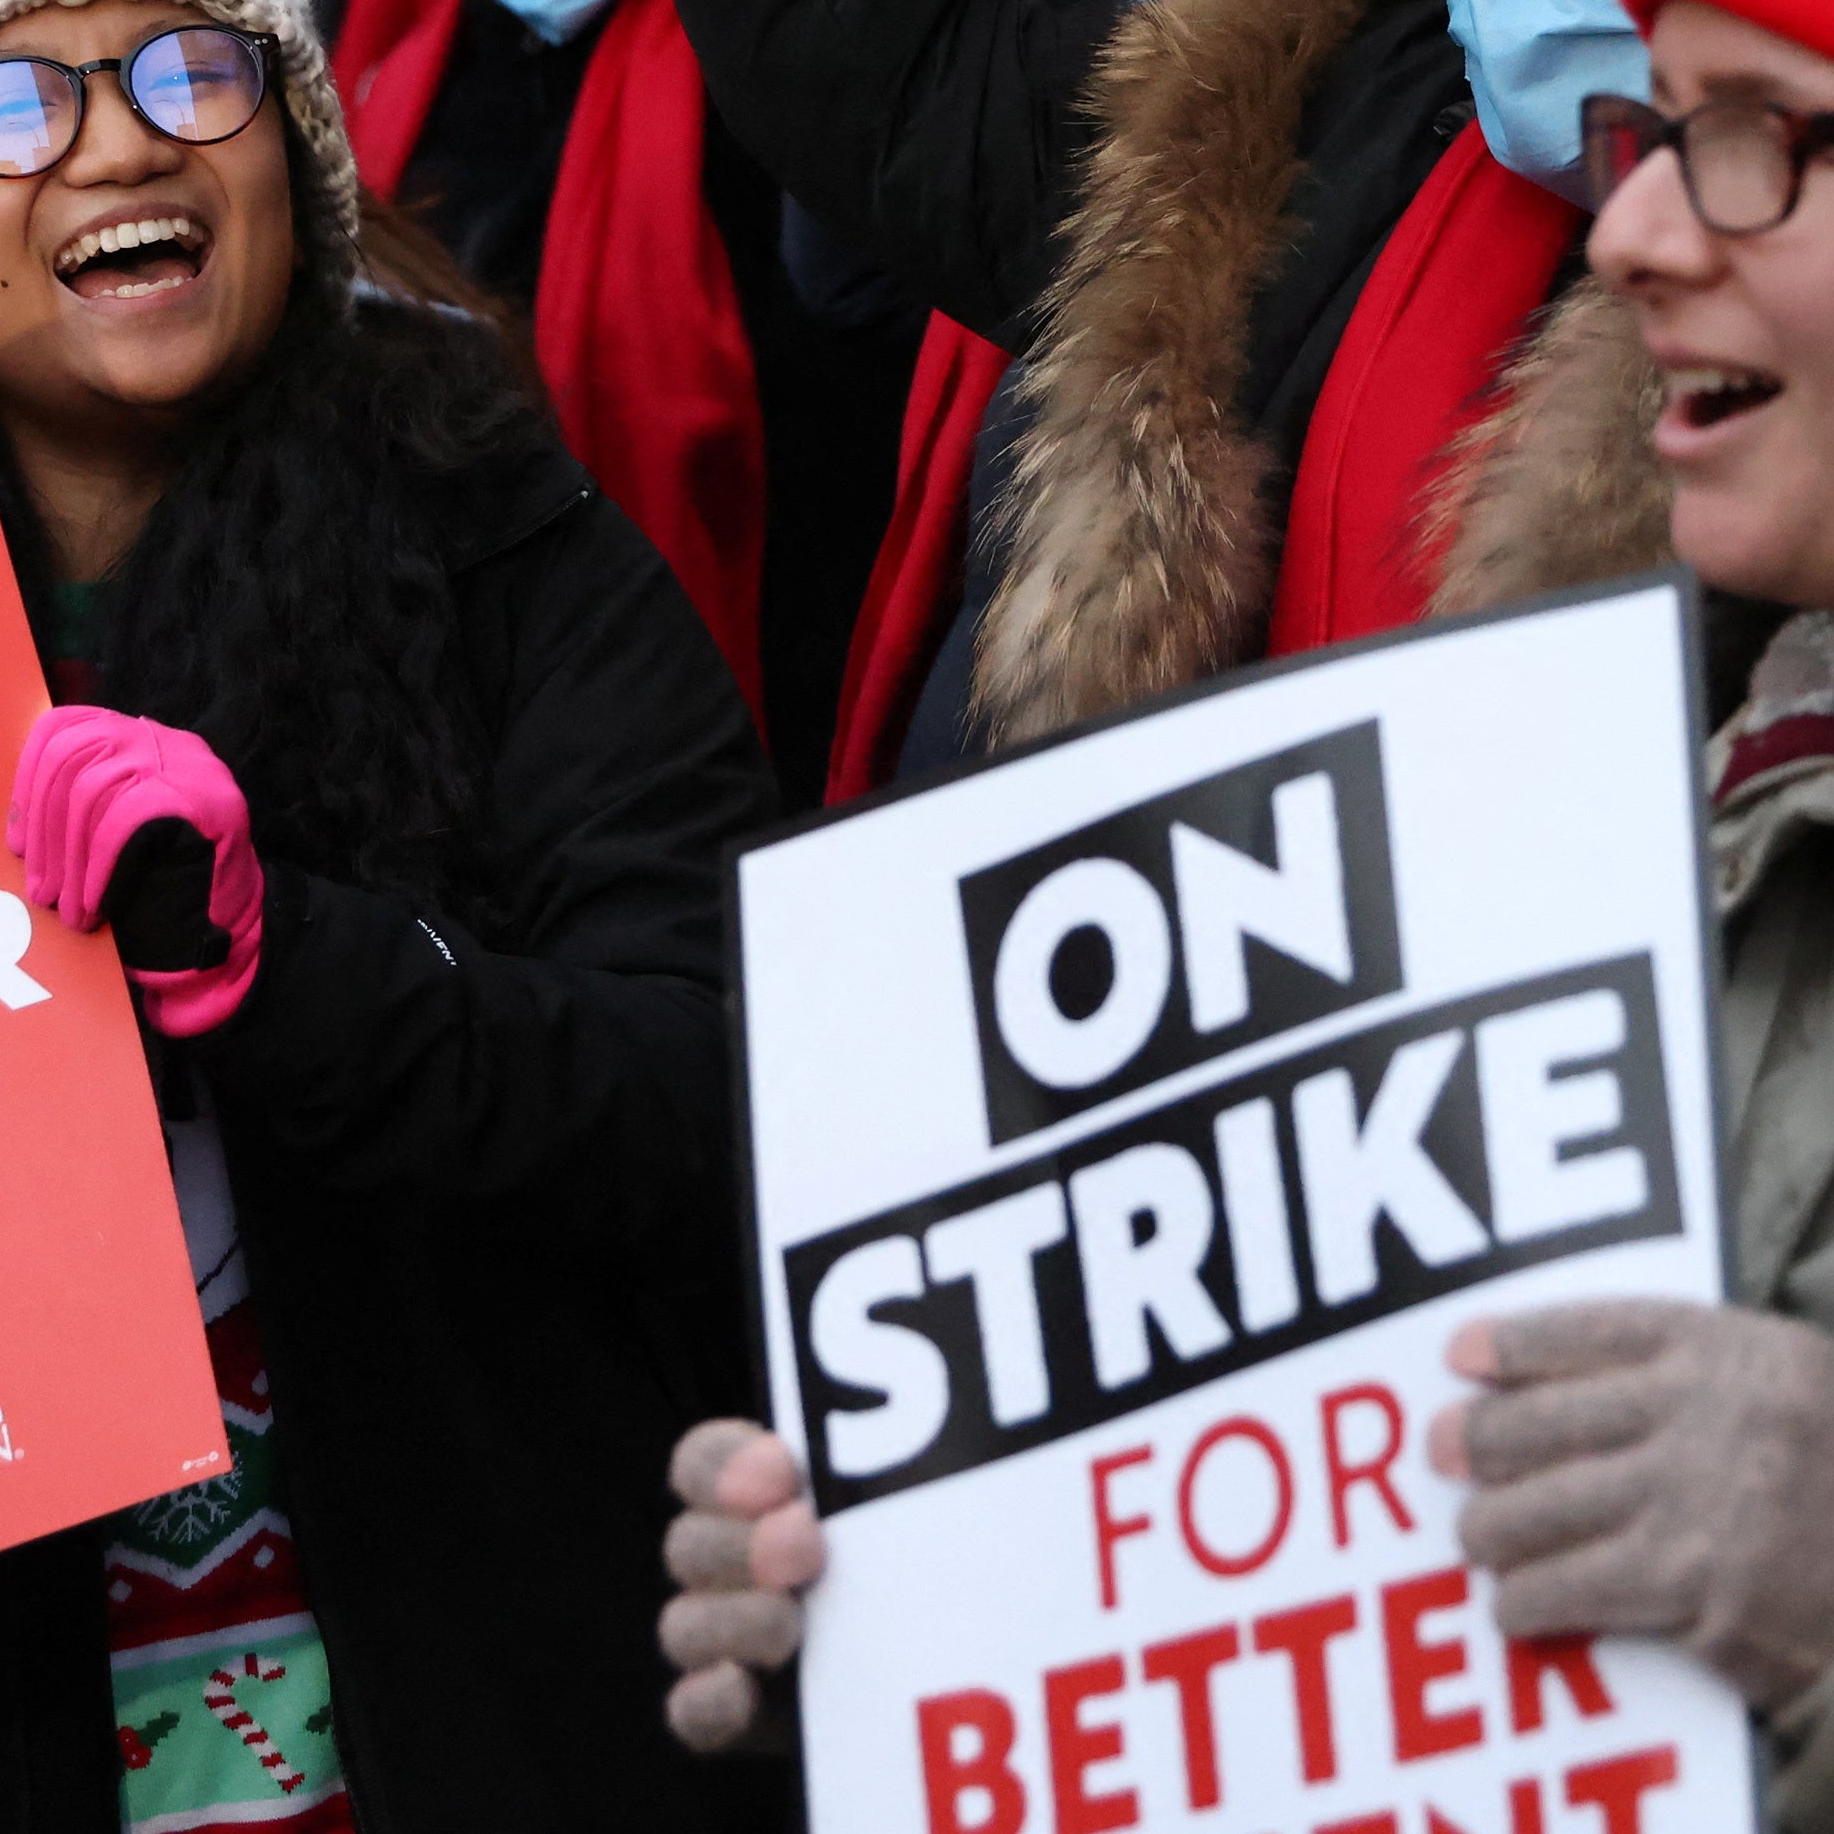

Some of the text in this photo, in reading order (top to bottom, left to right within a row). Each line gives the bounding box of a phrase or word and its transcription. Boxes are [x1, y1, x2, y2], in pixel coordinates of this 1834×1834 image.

[993, 771, 1354, 1089] ON
[810, 987, 1647, 1482] STRIKE
[1090, 1380, 1417, 1610] FOR
